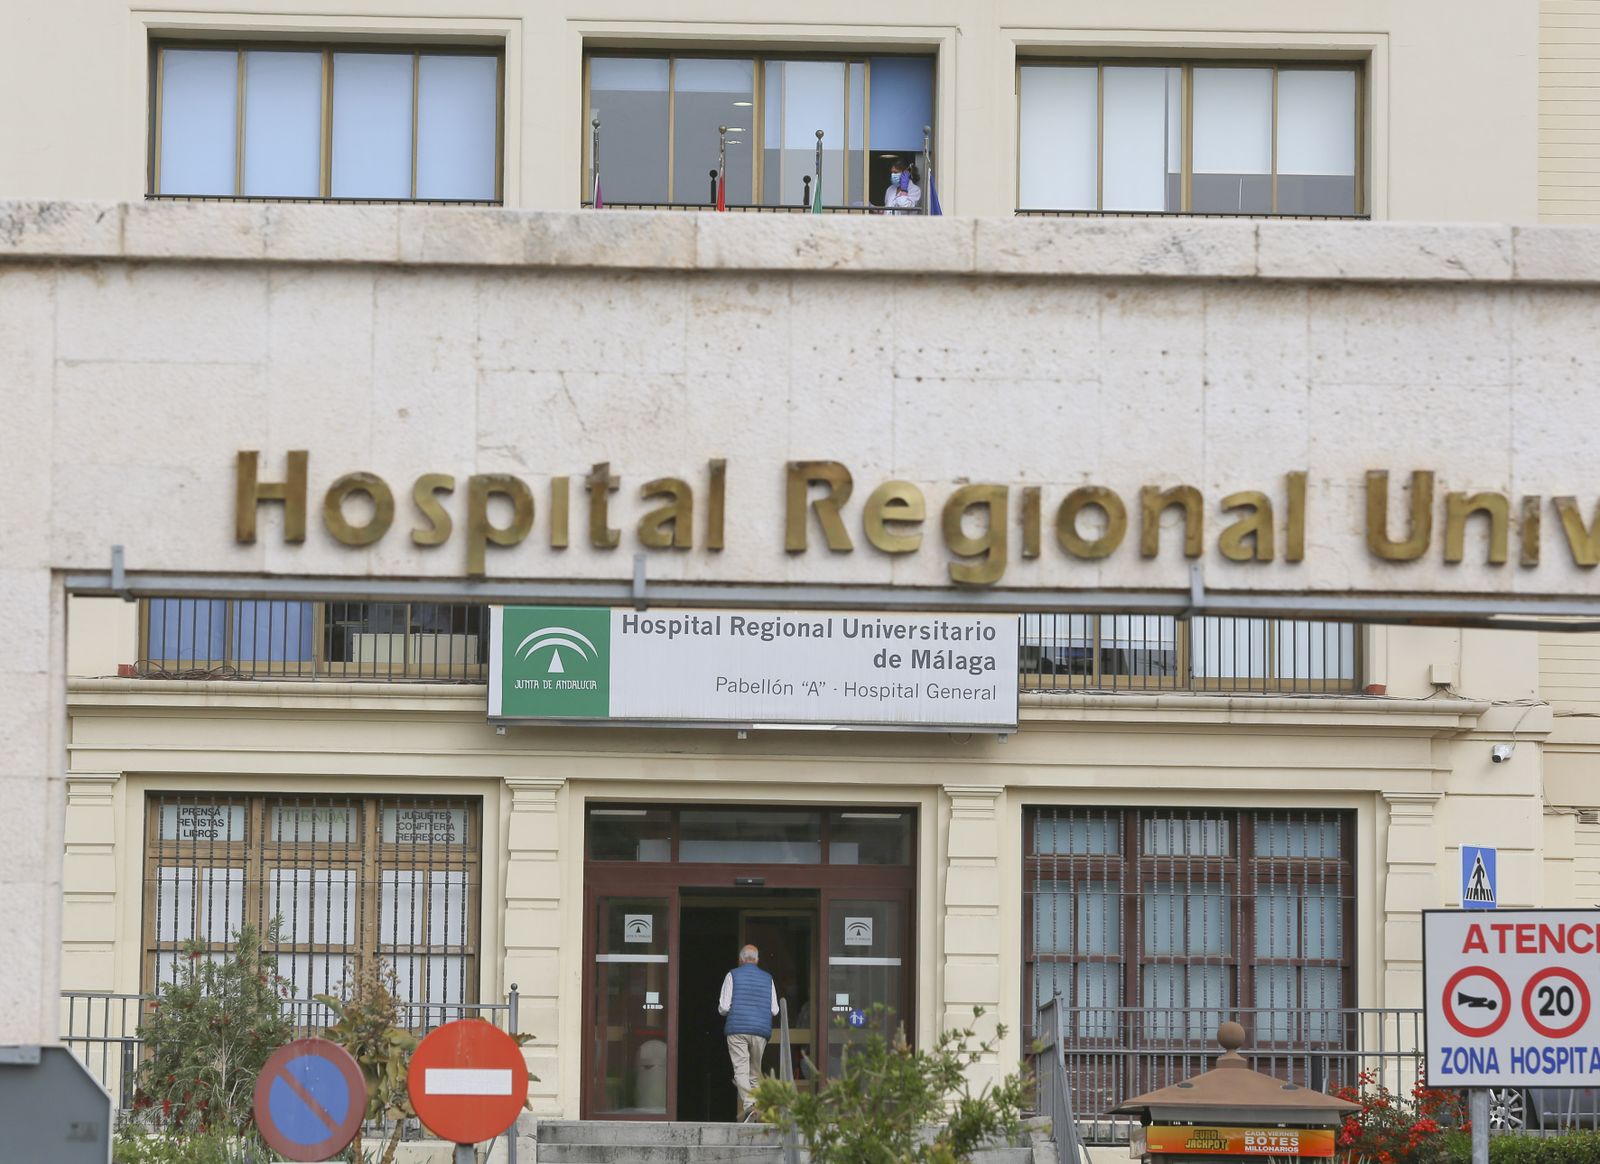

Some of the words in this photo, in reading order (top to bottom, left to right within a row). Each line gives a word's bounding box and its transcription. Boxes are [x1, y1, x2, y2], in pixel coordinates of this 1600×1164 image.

[236, 450, 727, 575] Hospital
[785, 459, 1307, 584] Regional
[622, 614, 721, 640] Hospital
[730, 616, 832, 642] Regional
[842, 618, 996, 641] Universitario
[873, 648, 902, 669] de
[911, 649, 996, 676] Málaga
[514, 679, 540, 689] JUNTA
[543, 679, 553, 690] DE
[716, 676, 794, 696] Pabellón
[844, 682, 919, 701] Hospital
[926, 683, 996, 701] General
[182, 807, 221, 817] PRENSA
[284, 808, 346, 824] TENDA
[178, 818, 225, 828] REVISTAS
[398, 821, 456, 831] CONFITERA
[183, 829, 219, 838] LIBROS
[1538, 985, 1575, 1017] 20
[1441, 1046, 1500, 1074] ZONA
[1511, 1046, 1600, 1075] HOSPITA
[1194, 1130, 1218, 1140] EURO
[1185, 1139, 1227, 1150] JACKPOT
[1245, 1136, 1299, 1147] BOTES
[1244, 1145, 1299, 1153] MILLONARIOS
